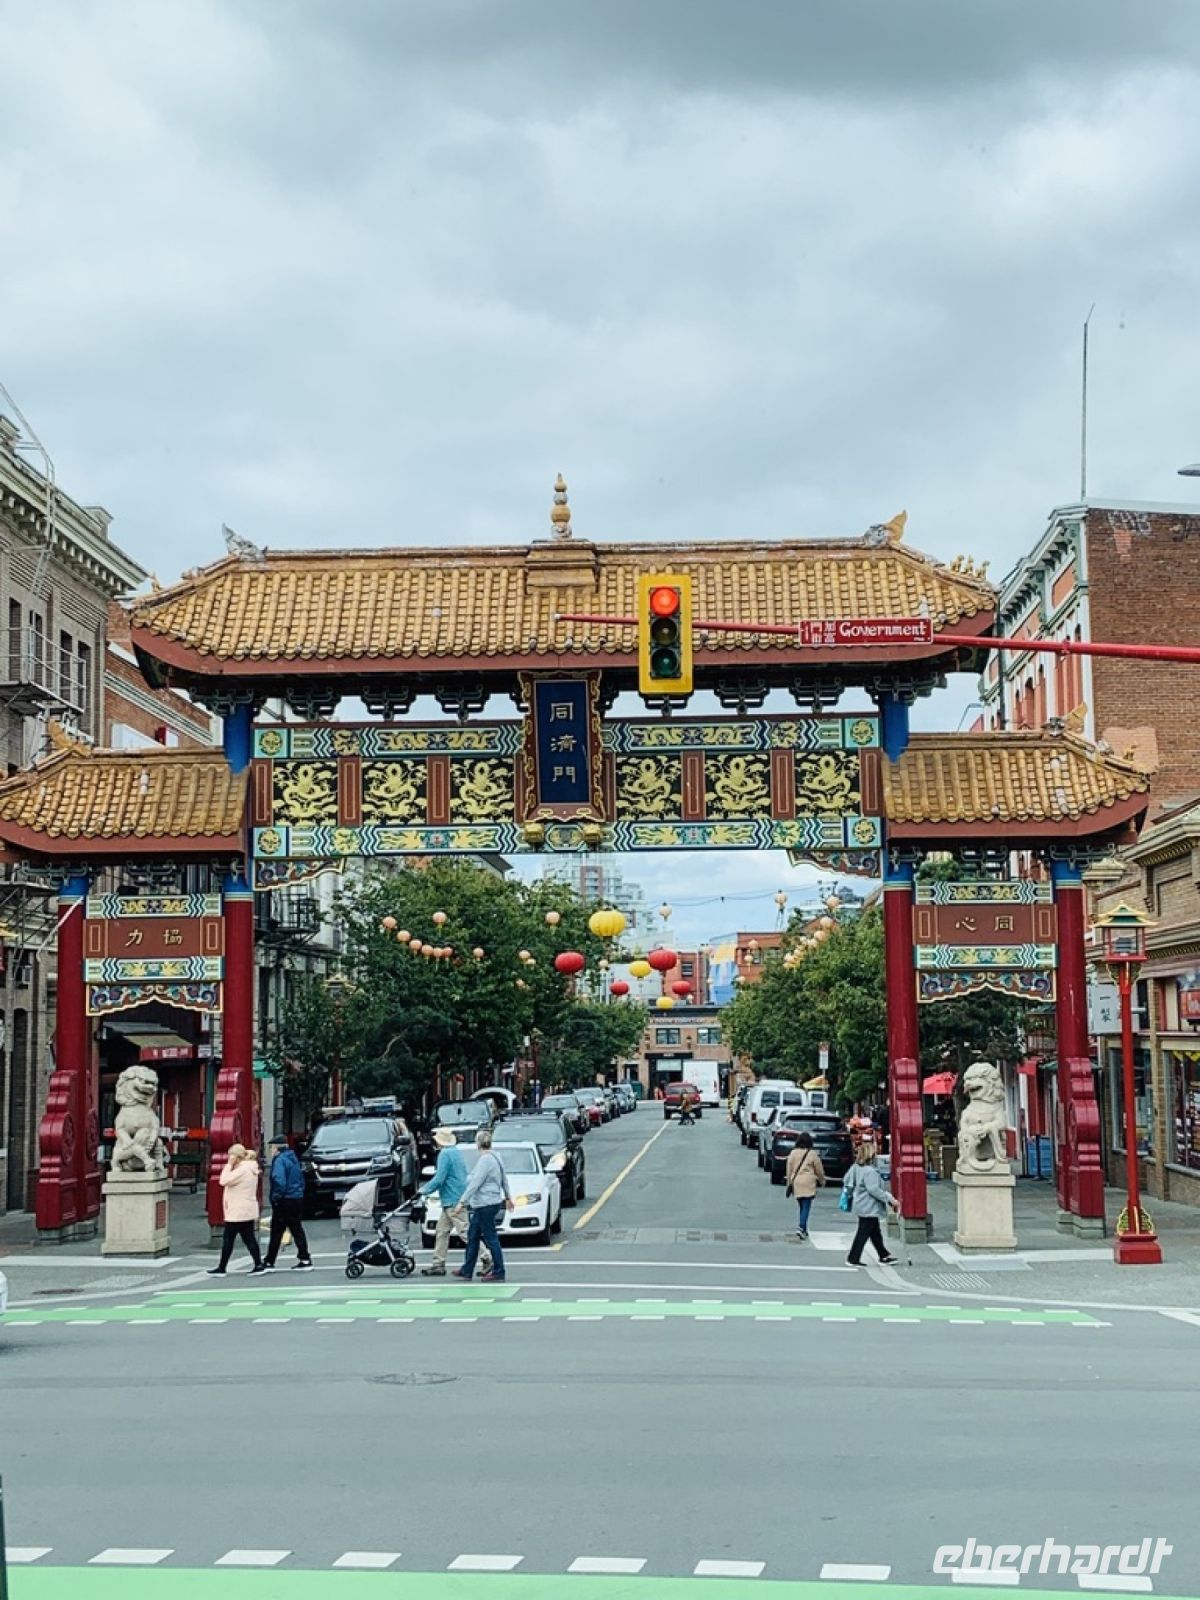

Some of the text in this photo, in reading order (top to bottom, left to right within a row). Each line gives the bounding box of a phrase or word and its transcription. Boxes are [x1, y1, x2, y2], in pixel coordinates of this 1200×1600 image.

[839, 621, 927, 637] Government
[550, 702, 577, 784] 同濟門
